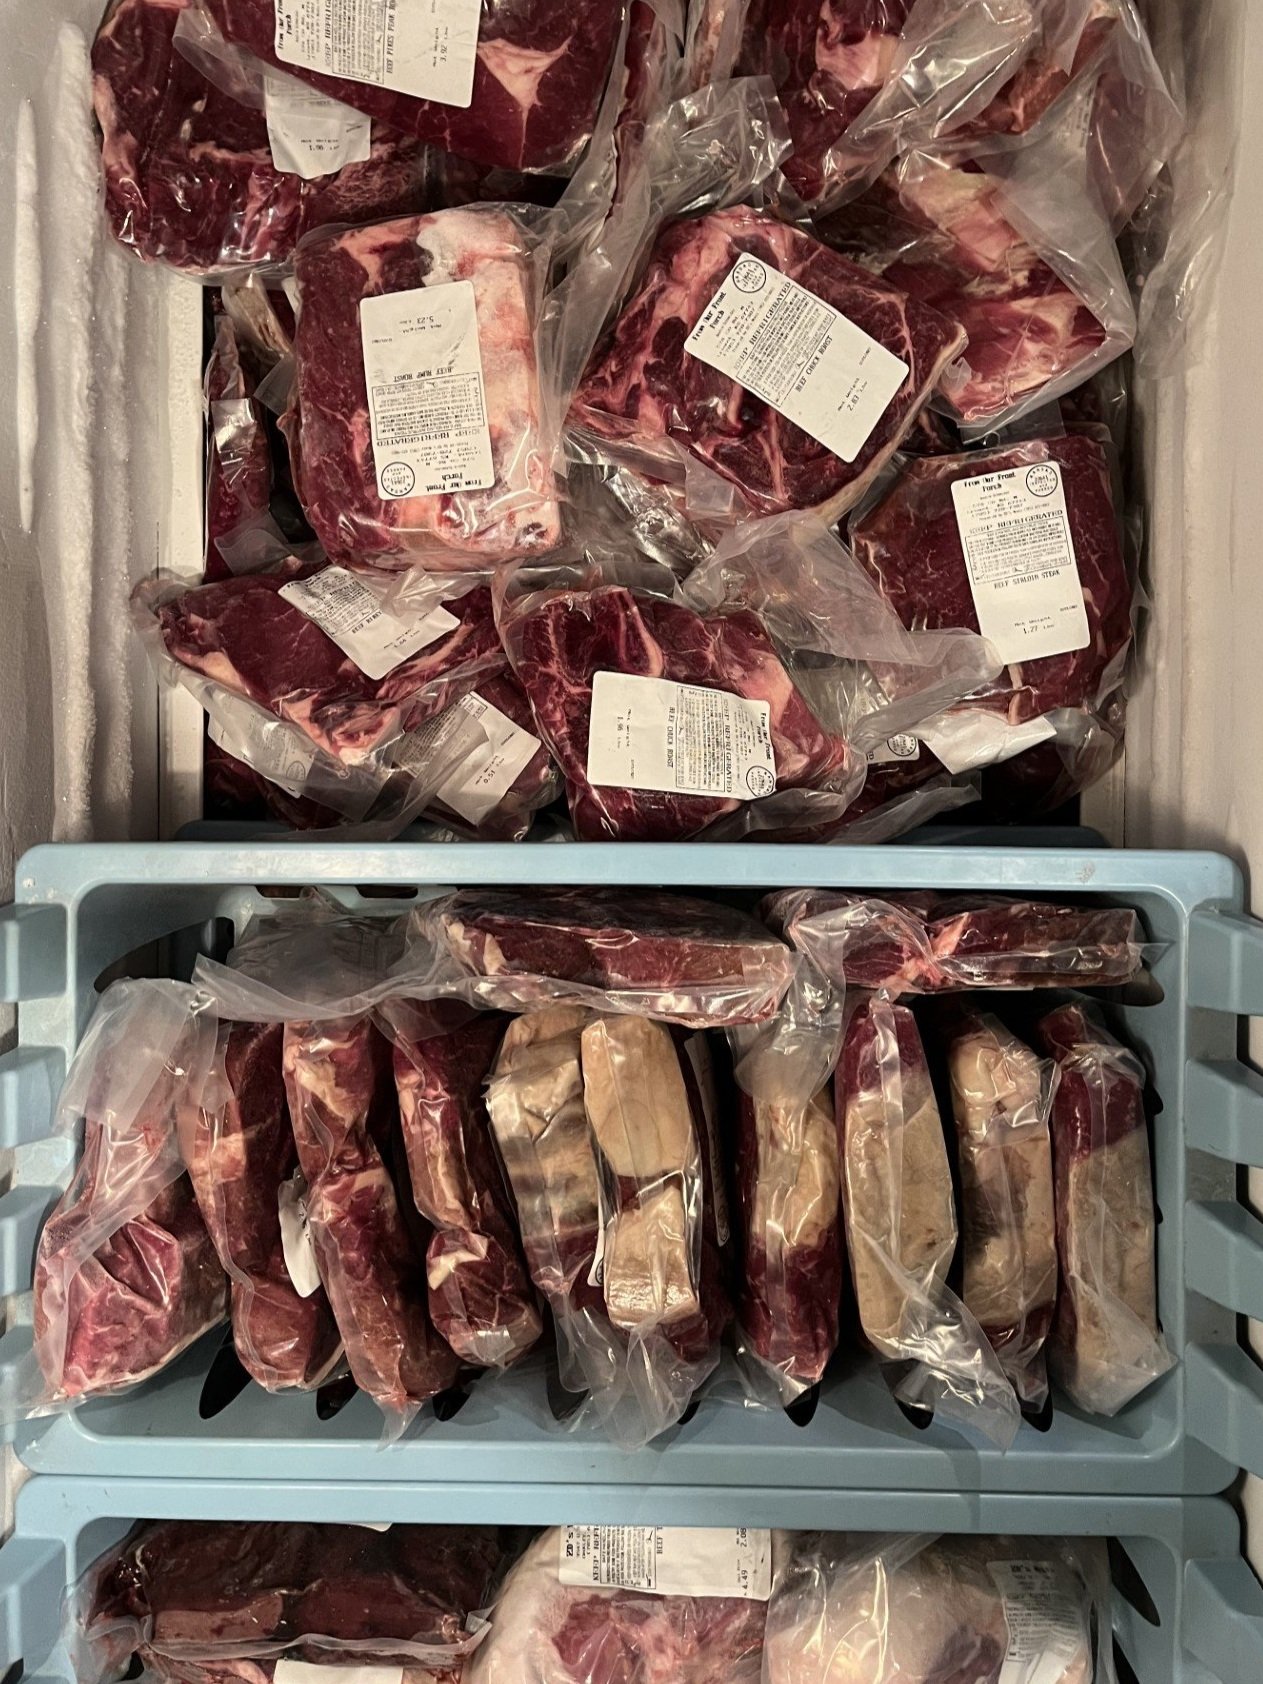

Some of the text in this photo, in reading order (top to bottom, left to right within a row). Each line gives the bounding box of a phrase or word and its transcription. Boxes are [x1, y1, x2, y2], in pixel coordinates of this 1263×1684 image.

[416, 315, 433, 324] 5.23
[691, 290, 726, 340] From Our Front
[709, 309, 724, 328] Porch
[748, 281, 792, 344] REFRIGERATED
[435, 366, 451, 374] BEEF
[794, 334, 833, 392] BEEF CHUCK ROAST
[393, 373, 412, 381] ROAST
[376, 431, 449, 446] REFRIGERATED
[441, 472, 462, 480] Porch
[963, 479, 979, 487] From
[997, 471, 1015, 480] Front
[425, 483, 445, 492] Front
[982, 483, 1002, 491] Porch
[997, 509, 1063, 528] REFRIGERATED
[1013, 574, 1039, 584] SIRLOIN
[1042, 569, 1060, 577] STEAK
[722, 724, 733, 792] REFRIGERATED
[482, 769, 496, 784] 0.51
